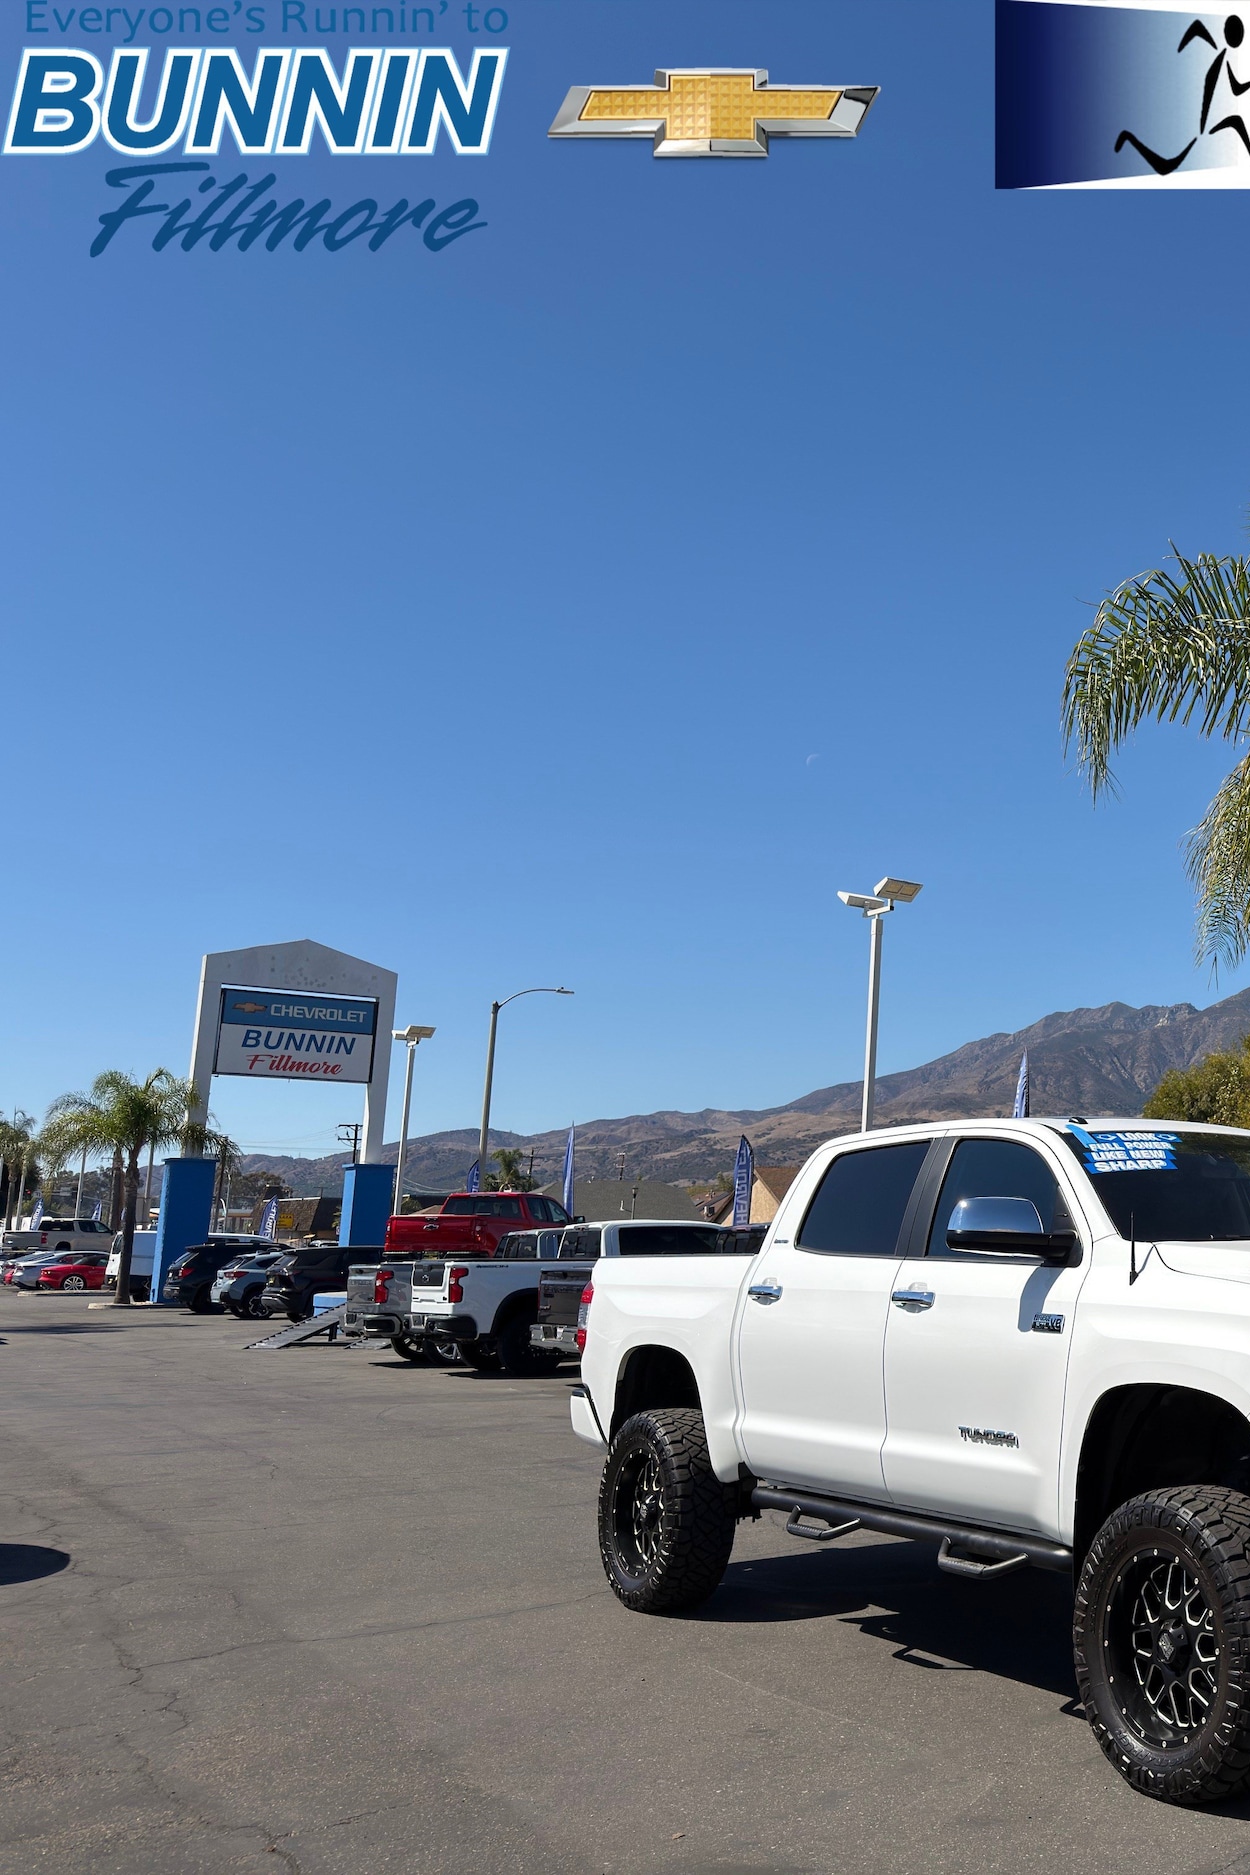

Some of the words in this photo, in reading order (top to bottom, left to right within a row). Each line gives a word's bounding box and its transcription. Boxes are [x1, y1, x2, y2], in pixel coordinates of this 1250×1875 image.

[270, 1003, 367, 1023] CHEVROLET
[241, 1029, 357, 1055] BUNNIN
[245, 1054, 343, 1075] Fillmore
[1117, 1132, 1160, 1141] LOOK
[1089, 1143, 1125, 1151] FULL
[1124, 1141, 1172, 1150] POWER
[1091, 1151, 1129, 1160] LIKE
[1129, 1150, 1166, 1159] NEW
[1094, 1160, 1167, 1172] SHARP
[958, 1425, 1019, 1448] TUNDRA
